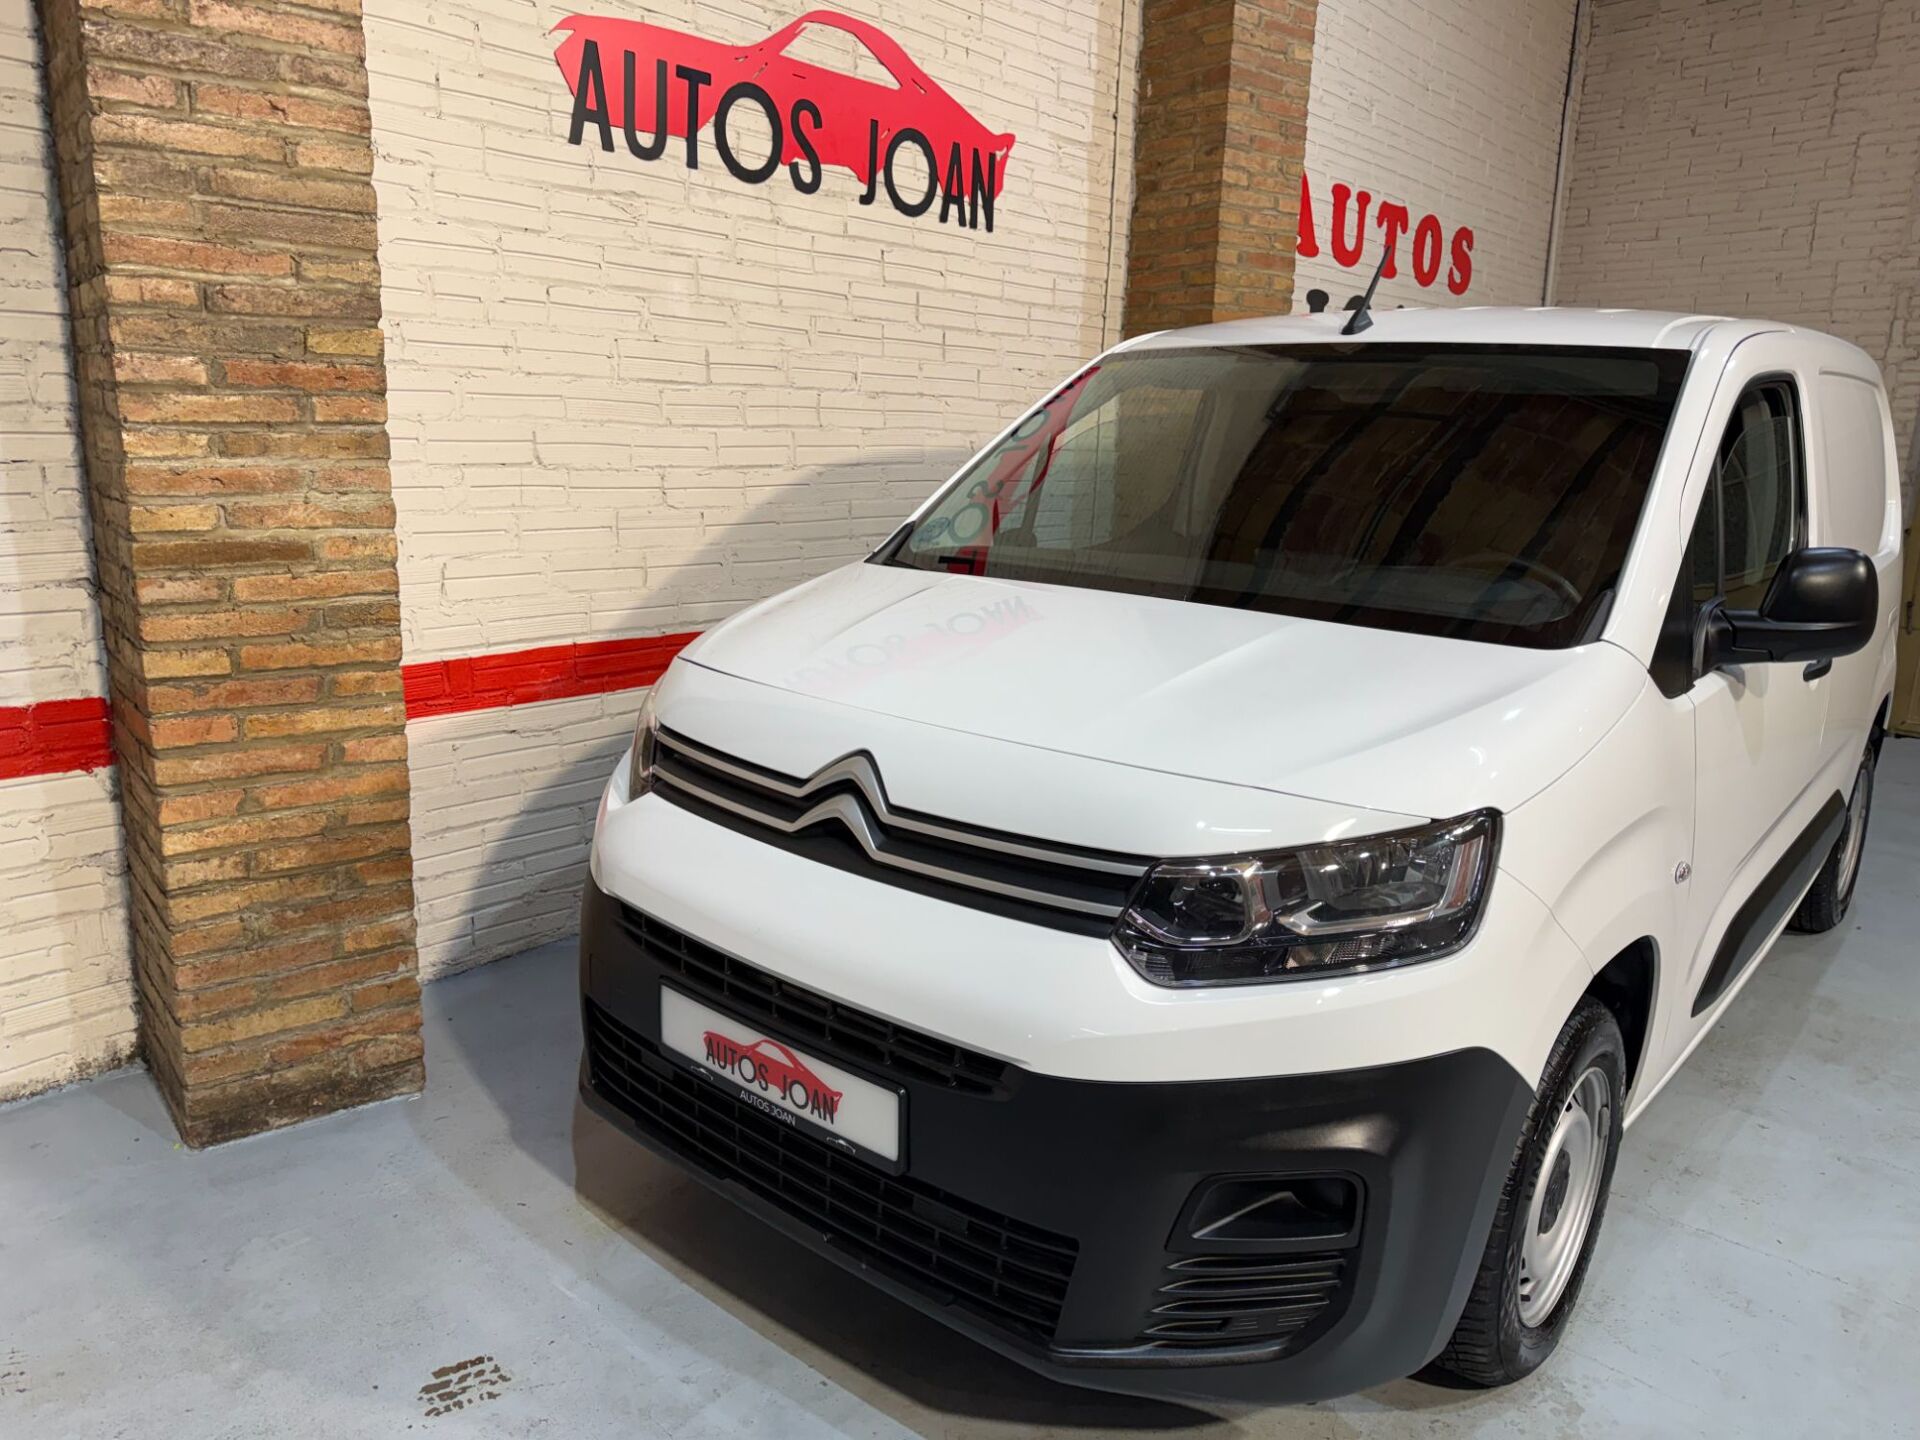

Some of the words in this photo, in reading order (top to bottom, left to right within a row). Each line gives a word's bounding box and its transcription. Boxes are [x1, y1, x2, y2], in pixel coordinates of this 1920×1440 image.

[567, 38, 823, 195] AUTOS
[859, 118, 997, 233] JOAN
[1296, 172, 1474, 296] AUTOS
[705, 1036, 769, 1092] AUTOS
[780, 1074, 835, 1125] JOAN
[739, 1089, 770, 1113] AUTOS
[771, 1103, 796, 1126] JOAN
